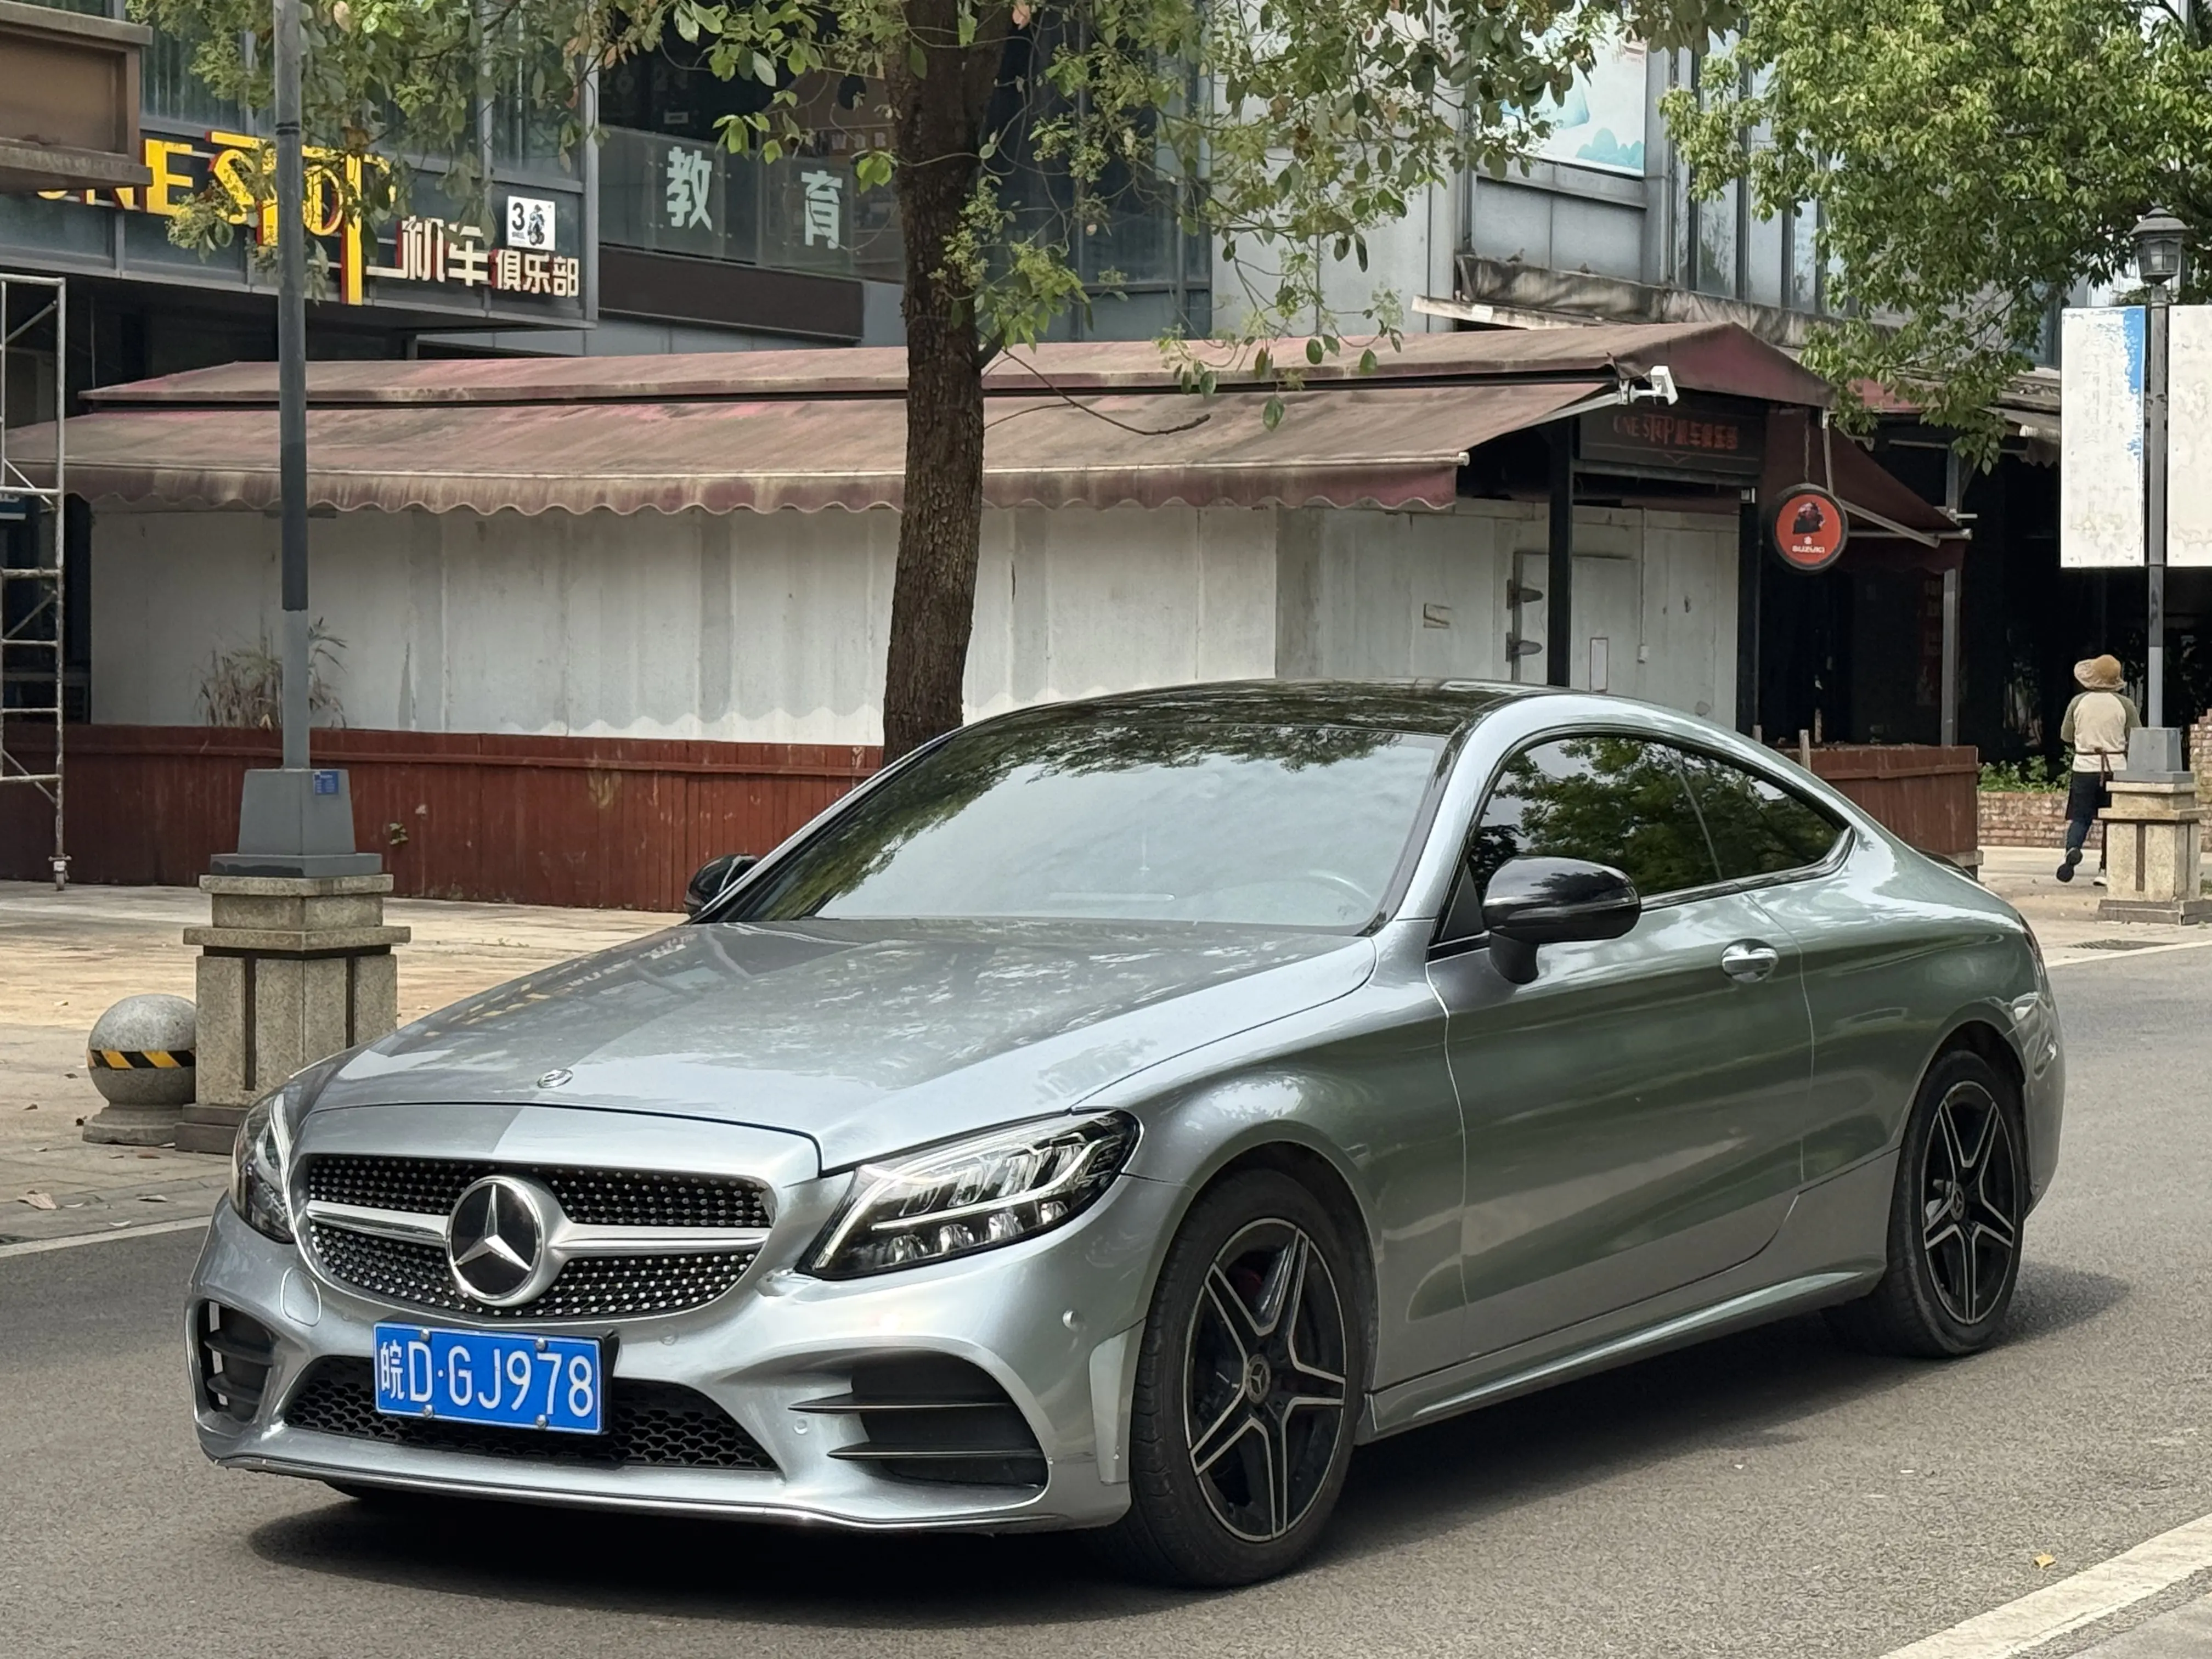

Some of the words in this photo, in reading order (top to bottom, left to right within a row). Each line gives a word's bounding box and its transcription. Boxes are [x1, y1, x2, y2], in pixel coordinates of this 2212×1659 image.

[512, 202, 526, 231] 3
[667, 146, 843, 250] 教育
[380, 1339, 594, 1418] 皖D·GJ978
